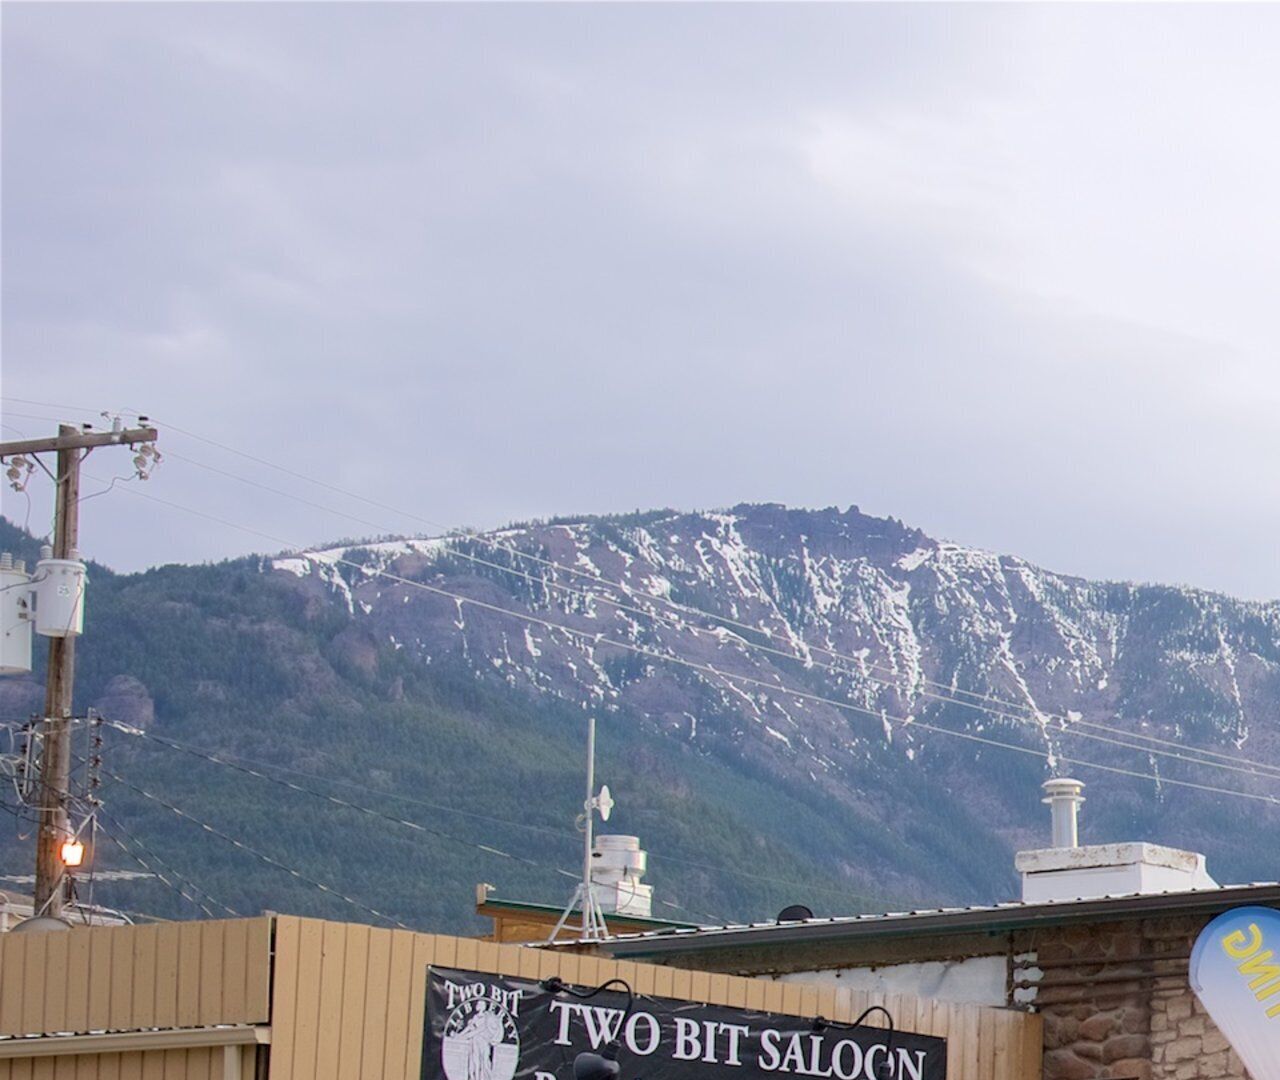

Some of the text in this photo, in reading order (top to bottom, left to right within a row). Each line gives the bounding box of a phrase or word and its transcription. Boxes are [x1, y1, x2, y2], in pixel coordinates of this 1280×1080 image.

[444, 980, 524, 1018] TWO BIT
[549, 1000, 660, 1056] TWO
[672, 1017, 749, 1067] BIT
